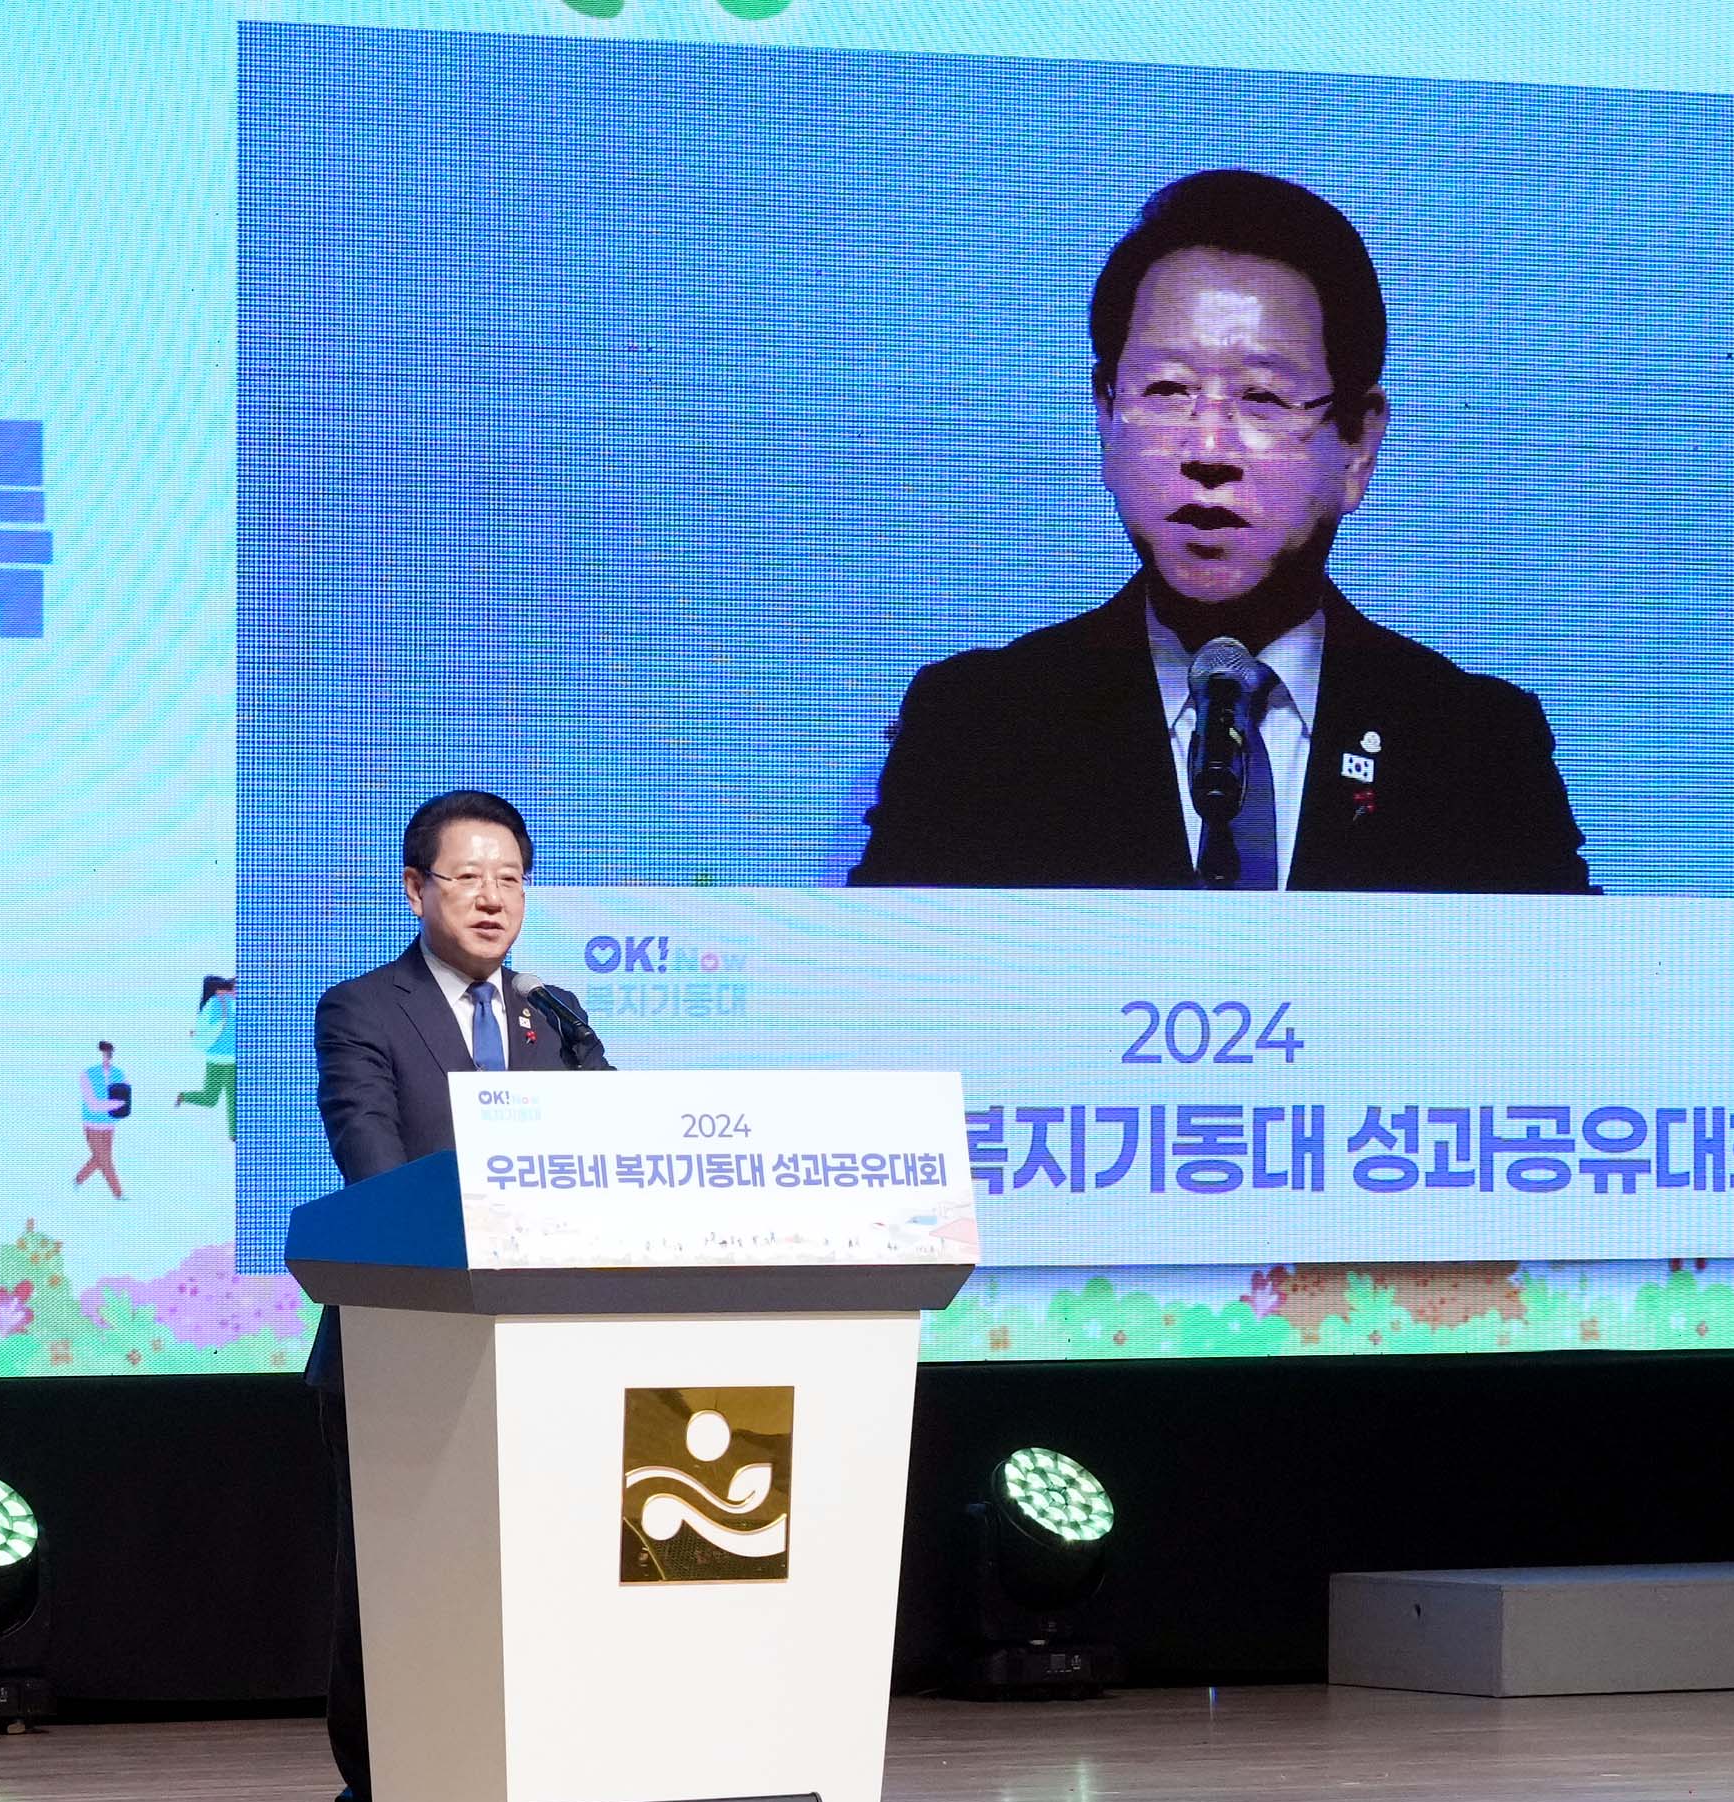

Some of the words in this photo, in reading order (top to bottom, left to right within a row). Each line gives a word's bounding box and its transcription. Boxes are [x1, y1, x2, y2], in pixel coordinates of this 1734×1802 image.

[584, 935, 669, 974] OK!
[1121, 1000, 1305, 1065] 2024
[478, 1090, 511, 1105] OK!
[681, 1113, 753, 1138] 2024
[486, 1154, 609, 1190] 우리동네
[615, 1153, 766, 1189] 복지기동대
[771, 1152, 948, 1188] 성과공유대회
